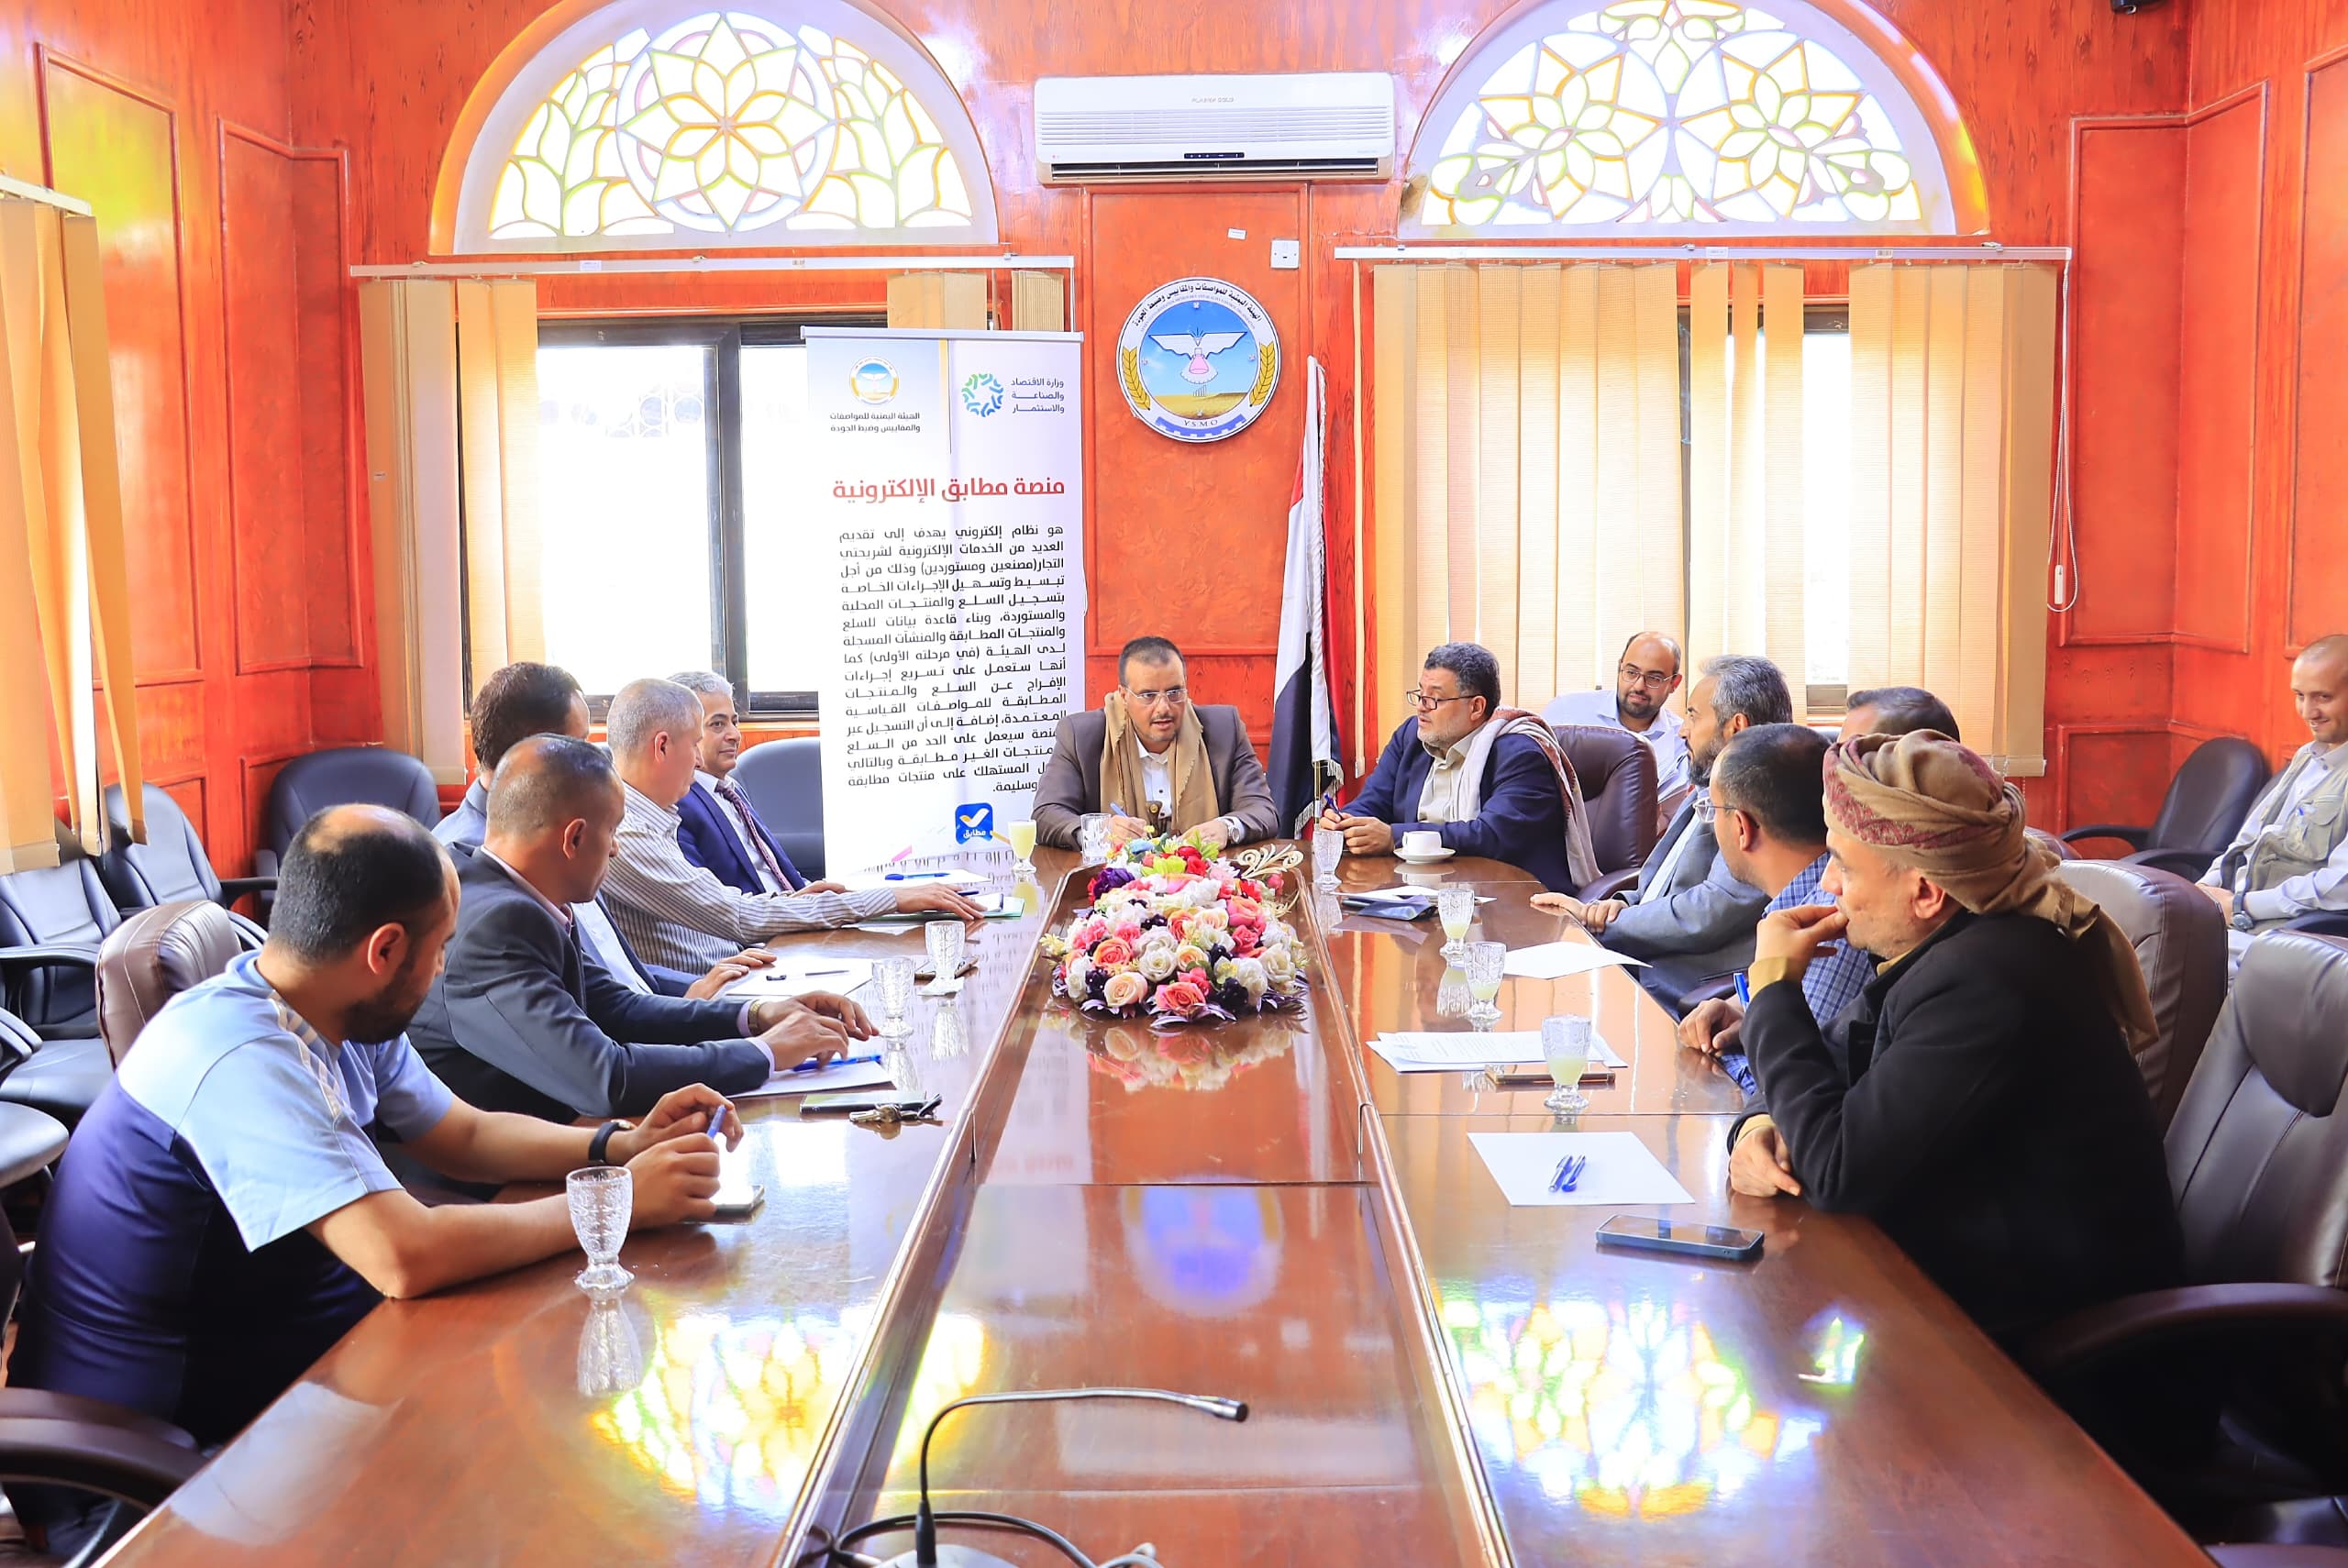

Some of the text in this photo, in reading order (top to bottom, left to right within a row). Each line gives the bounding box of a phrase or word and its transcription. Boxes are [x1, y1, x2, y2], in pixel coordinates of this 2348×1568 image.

[1010, 378, 1064, 388] وزارة الاقتصاد
[1011, 392, 1064, 401] والصناعة
[1012, 404, 1064, 414] والاستثمار
[832, 477, 1064, 503] منصة مطابق الإلكترونية
[838, 525, 1063, 543] هو نظام إلكتروني يهدف إلى تقديم
[839, 541, 1063, 559] العديد من الخدمات الإلكترونية لشريحتي
[840, 562, 859, 578] أجل
[865, 568, 881, 578] من
[887, 564, 915, 576] وذلك
[840, 576, 1064, 593] تبسيط وتسهيل الإجراءات الخاصة
[841, 592, 1064, 613] بتسجيل السلع والمنتجات المحلية
[842, 617, 875, 631] للسلع
[885, 616, 915, 628] بيانات
[925, 613, 957, 624] قاعدة
[965, 613, 991, 625] وبناء
[843, 626, 1065, 647] والمنتجات المطابقة والمنشآت المسجلة
[985, 645, 1030, 657] الهيئة
[1036, 643, 1065, 653] لدى
[844, 653, 862, 663] كما
[915, 649, 949, 662] مرحلته
[844, 656, 1065, 683] أنها ستعمل على تسريع إجراءات
[845, 677, 1066, 698] الإفراج عن السلع والمنتجات
[845, 693, 1066, 717] المطابقة للمواصفات القياسية
[916, 716, 927, 731] أن
[930, 717, 953, 730] إلى
[956, 714, 998, 727] إضافة
[847, 726, 863, 737] عبر
[866, 720, 914, 734] التسجيل
[925, 735, 946, 745] الحد
[953, 734, 976, 743] على
[984, 732, 1024, 745] سيعمل
[847, 738, 893, 755] السلع
[902, 740, 917, 750] من
[847, 746, 1053, 769] منتجات الغير مطابقة وبالتالي
[942, 767, 966, 778] على
[973, 763, 1029, 776] المستهلك
[847, 775, 889, 786] مطابقة
[898, 772, 935, 782] منتجات
[992, 780, 1037, 792] وسليمة.
[962, 829, 986, 838] مطابق
